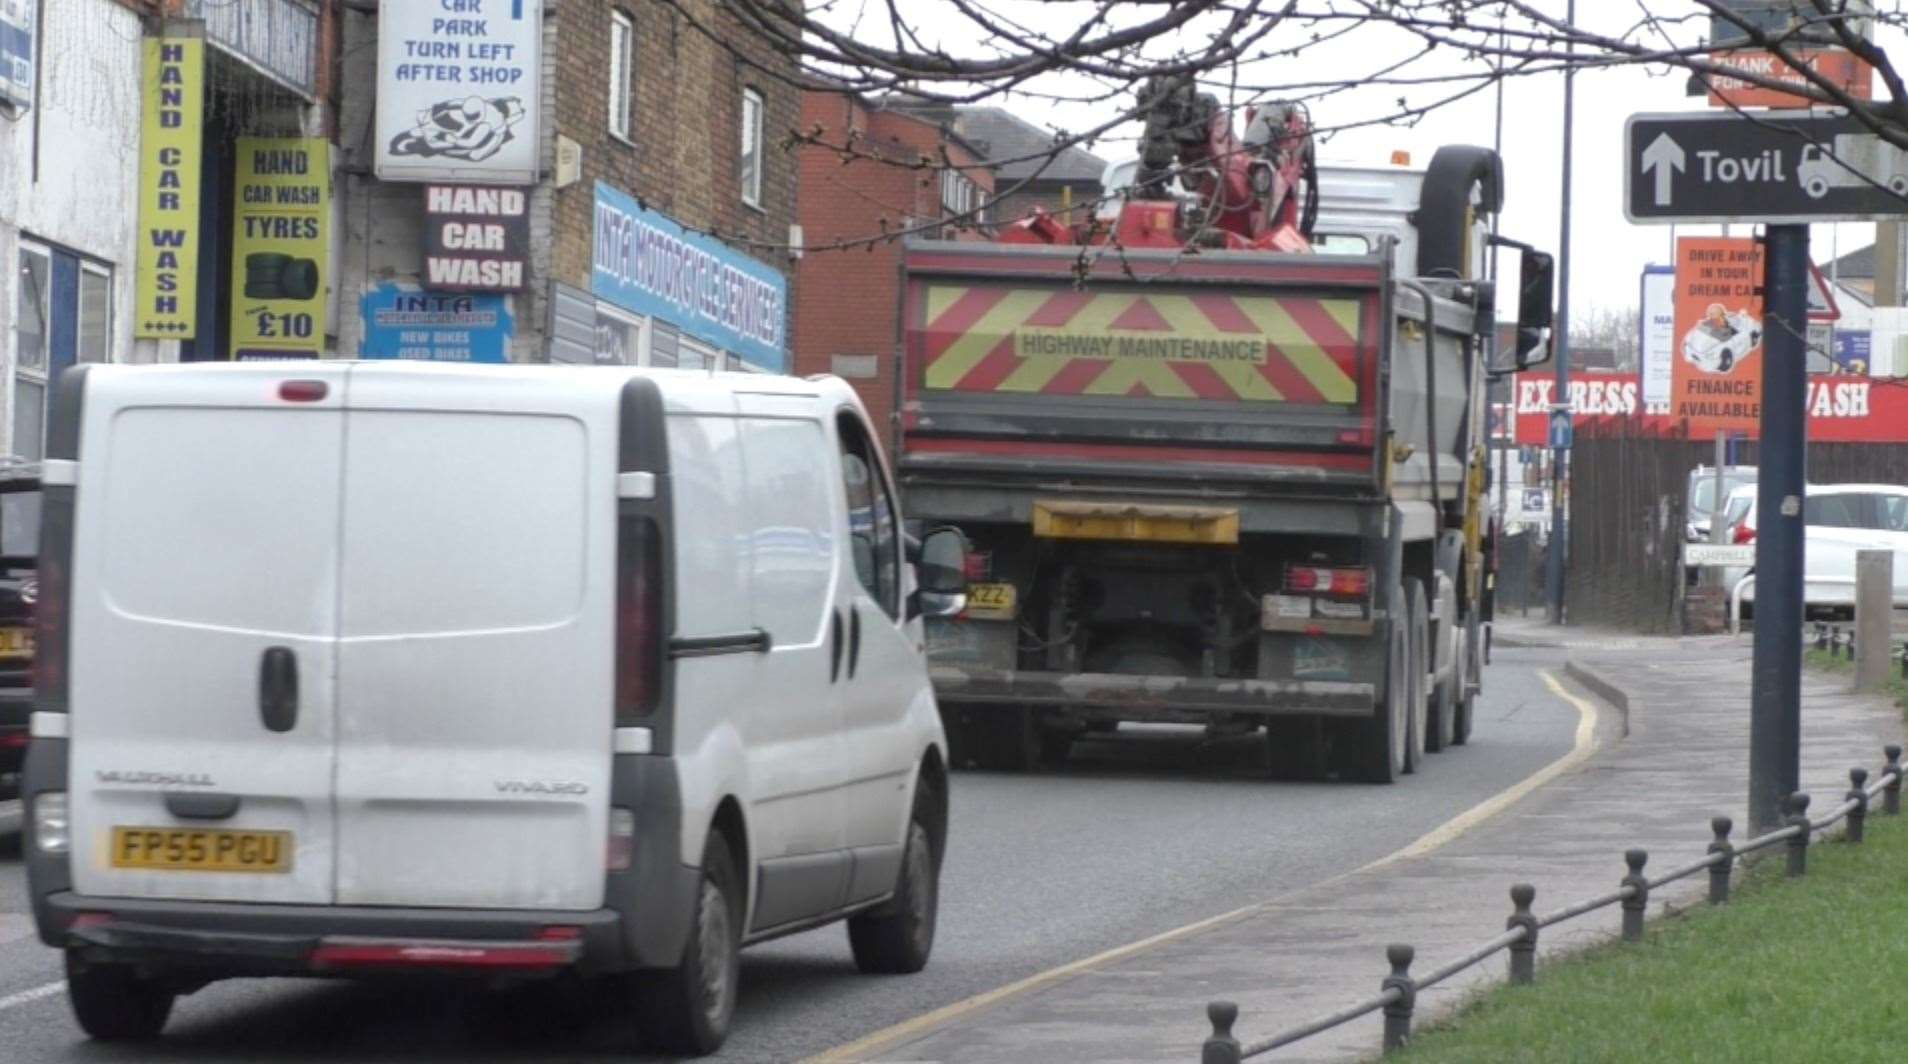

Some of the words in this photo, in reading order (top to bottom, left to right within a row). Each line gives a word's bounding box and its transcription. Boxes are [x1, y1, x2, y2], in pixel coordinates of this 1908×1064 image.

[441, 0, 481, 12] CAR
[432, 19, 487, 36] PARK
[405, 41, 459, 58] TURN
[468, 43, 515, 60] LEFT
[160, 44, 184, 128] HAND
[396, 64, 461, 82] AFTER
[469, 66, 523, 84] SHOP
[253, 150, 308, 175] HAND
[1696, 150, 1786, 182] Tovil
[158, 147, 182, 211] CAR
[243, 184, 273, 203] CAR
[278, 185, 320, 205] WASH
[427, 186, 525, 217] HAND
[244, 215, 319, 240] TYRES
[442, 223, 505, 251] CAR
[1688, 248, 1727, 263] DRIVE
[151, 229, 186, 314] WASH
[427, 257, 523, 288] WASH
[1716, 266, 1749, 280] YOUR
[1688, 284, 1731, 298] DREAM
[257, 313, 313, 339] £10
[1022, 333, 1112, 356] HIGHWAY
[1119, 335, 1263, 362] MAINTENANCE
[1687, 380, 1754, 396] FINANCE
[1677, 401, 1760, 418] AVAILABLE
[123, 830, 204, 862] FP55
[207, 834, 281, 865] PGU
